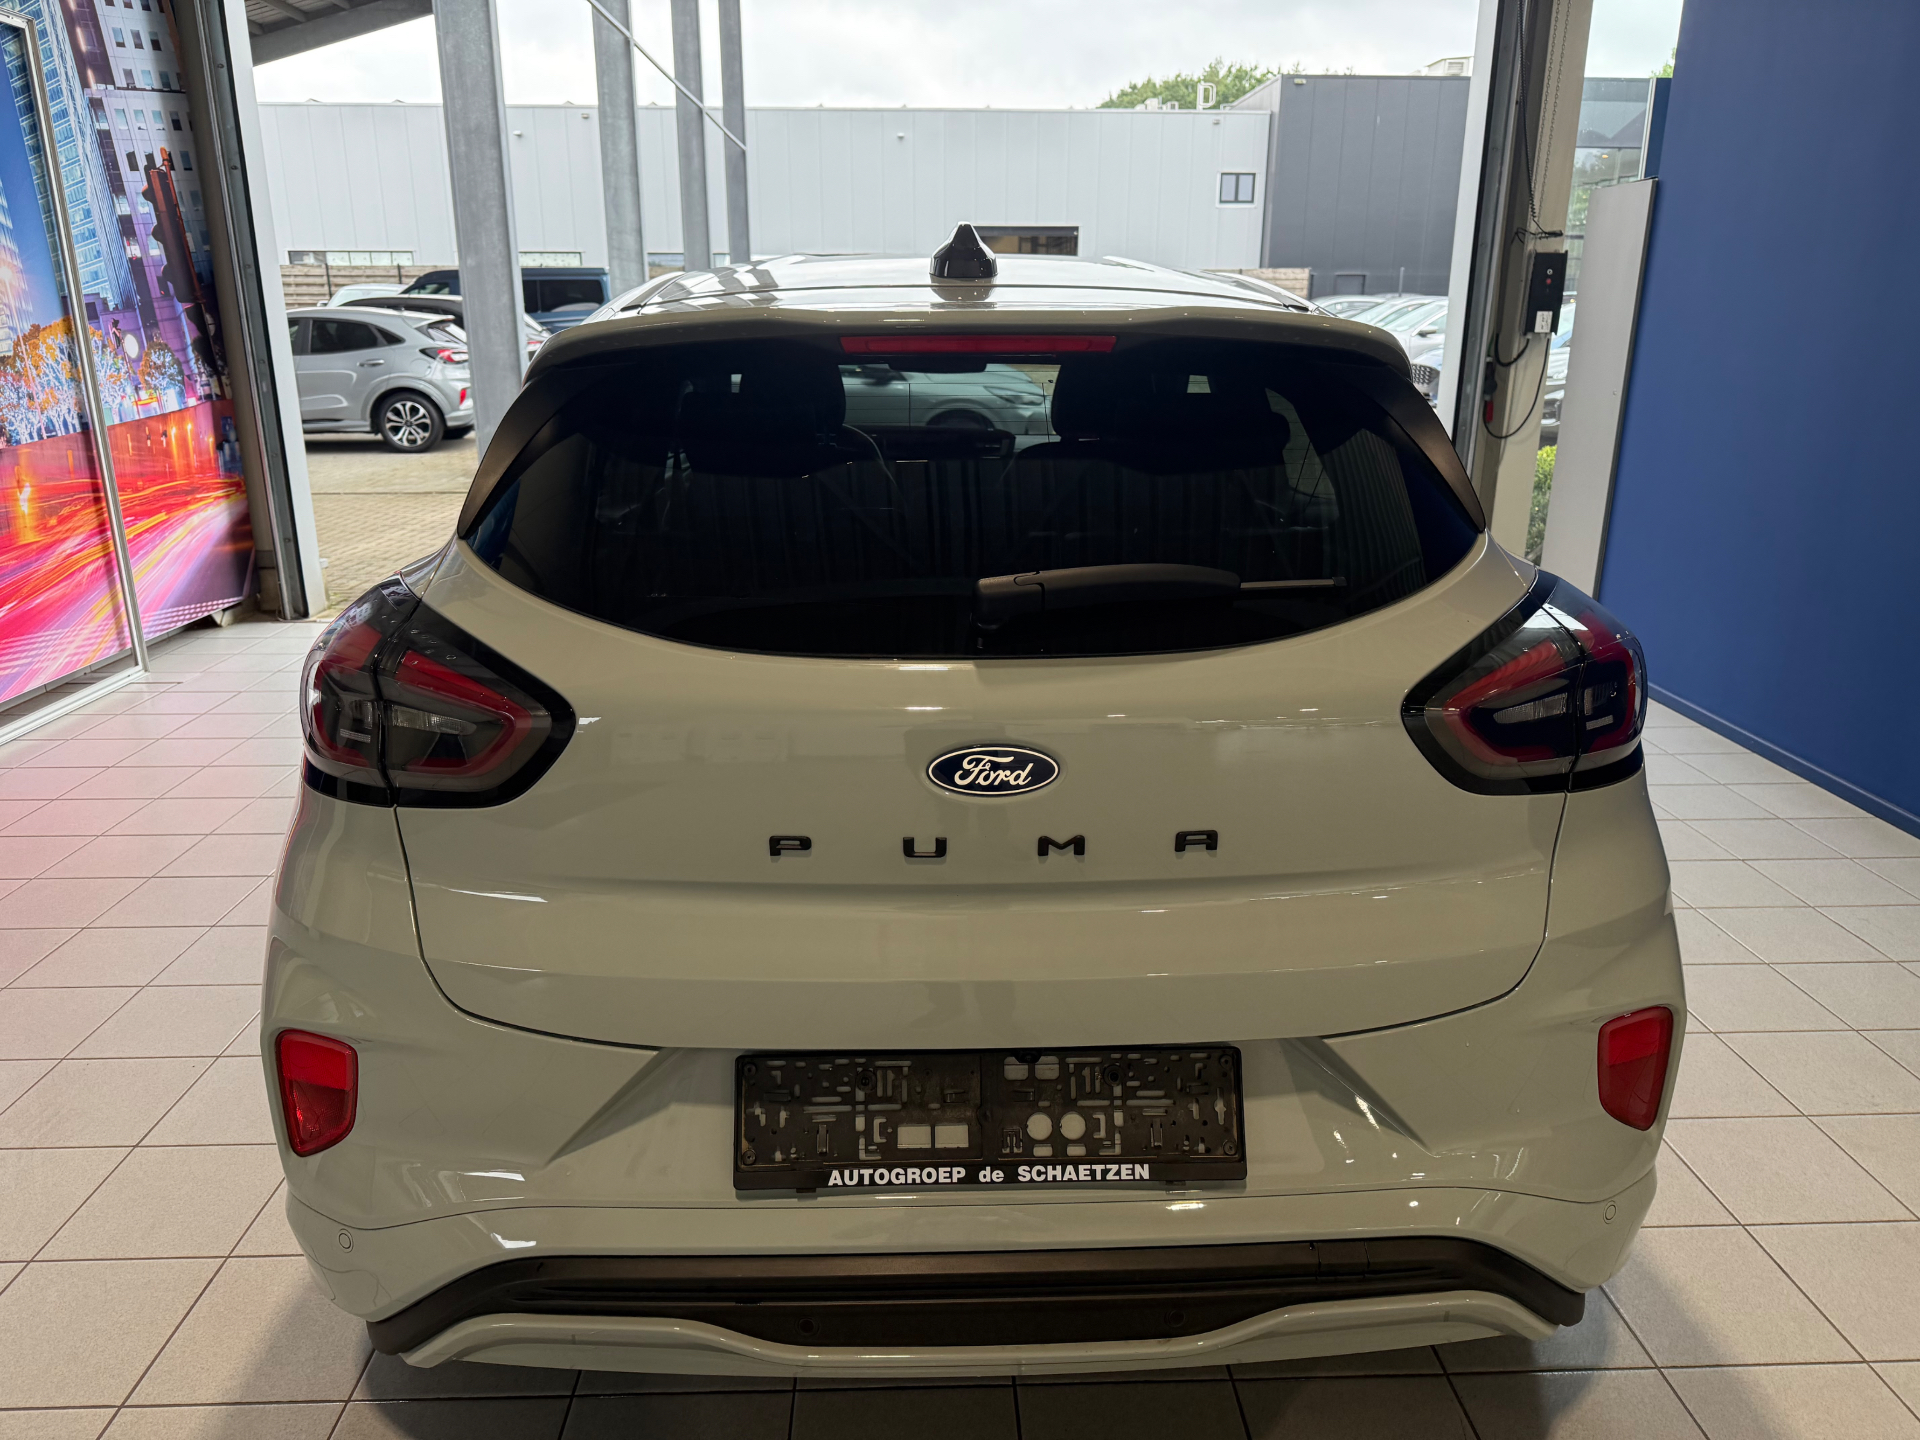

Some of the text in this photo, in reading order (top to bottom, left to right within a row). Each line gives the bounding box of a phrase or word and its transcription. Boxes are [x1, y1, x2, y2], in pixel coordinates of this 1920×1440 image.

[954, 754, 1034, 786] Ford
[768, 829, 1219, 858] PUMA
[827, 1163, 1150, 1186] AUTOGROEP de SCHAETZEN
